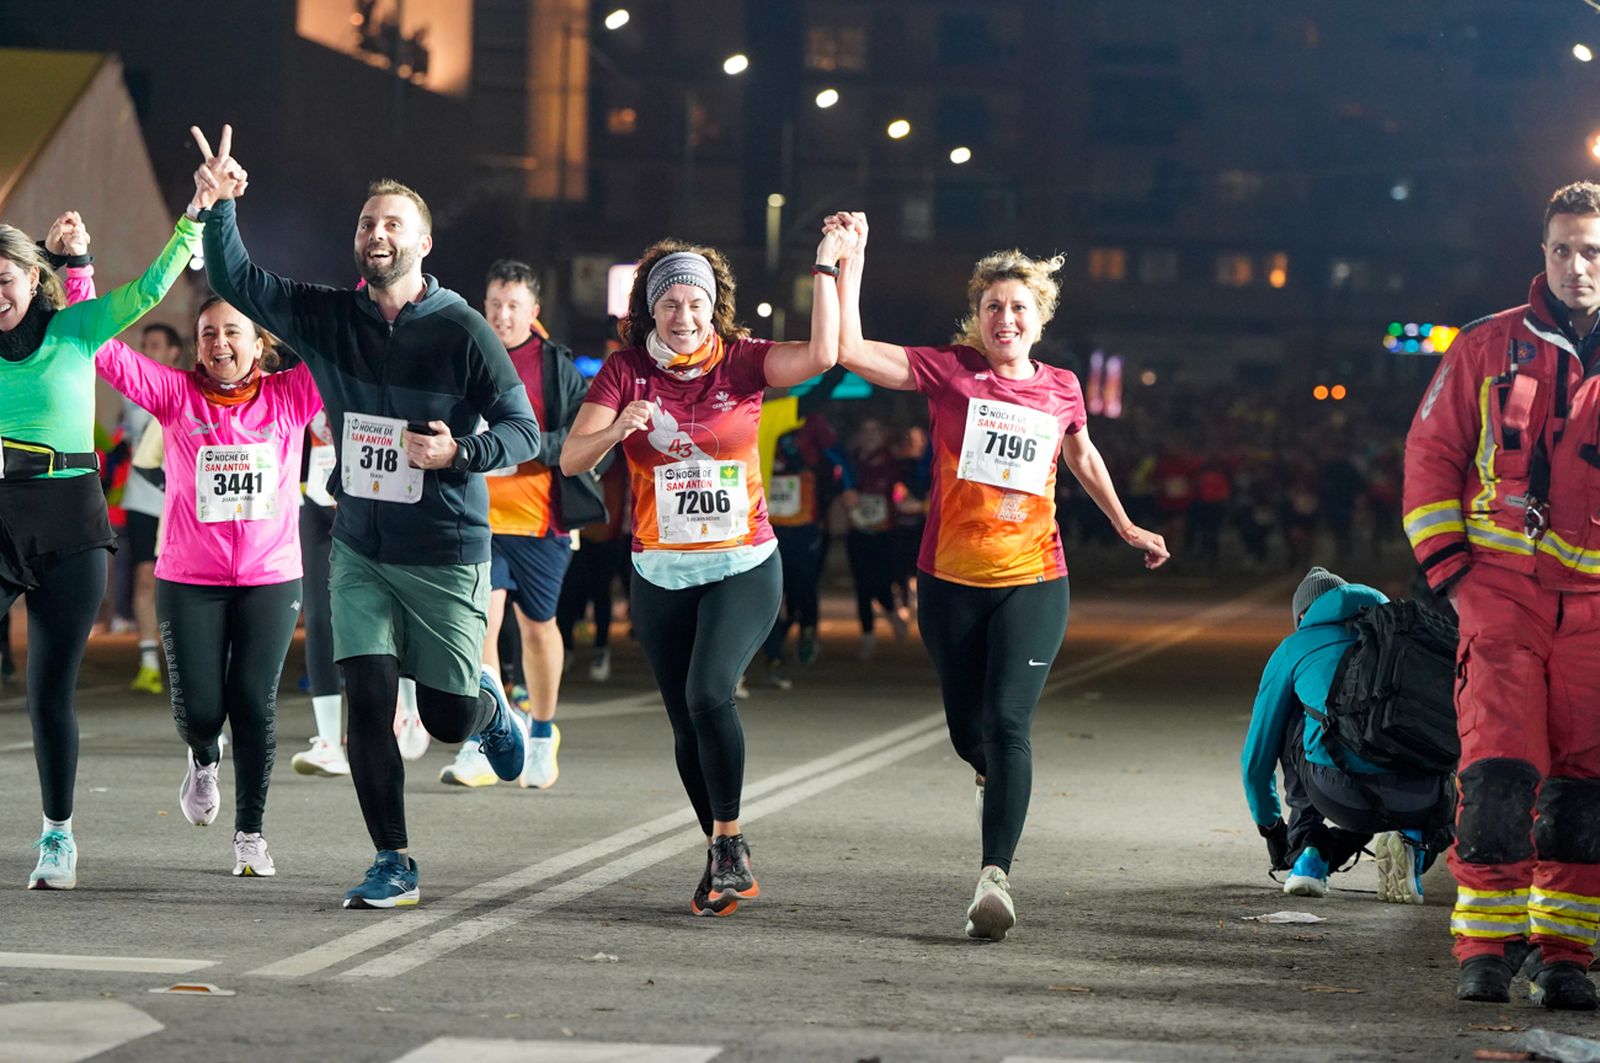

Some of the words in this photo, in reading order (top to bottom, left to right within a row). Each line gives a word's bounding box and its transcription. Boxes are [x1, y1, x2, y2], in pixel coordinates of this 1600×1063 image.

[359, 423, 383, 433] NOCHE
[383, 427, 394, 436] DE
[977, 418, 996, 429] SAN
[351, 433, 365, 443] SAN
[668, 438, 692, 458] 43
[984, 430, 1037, 462] 7196
[214, 453, 238, 462] NOCHE
[240, 453, 249, 461] DE
[360, 445, 398, 473] 318
[205, 463, 220, 472] SAN
[676, 470, 701, 479] NOCHE
[702, 470, 712, 478] DE
[214, 472, 262, 496] 3441
[666, 481, 684, 491] SAN
[675, 489, 731, 515] 7206
